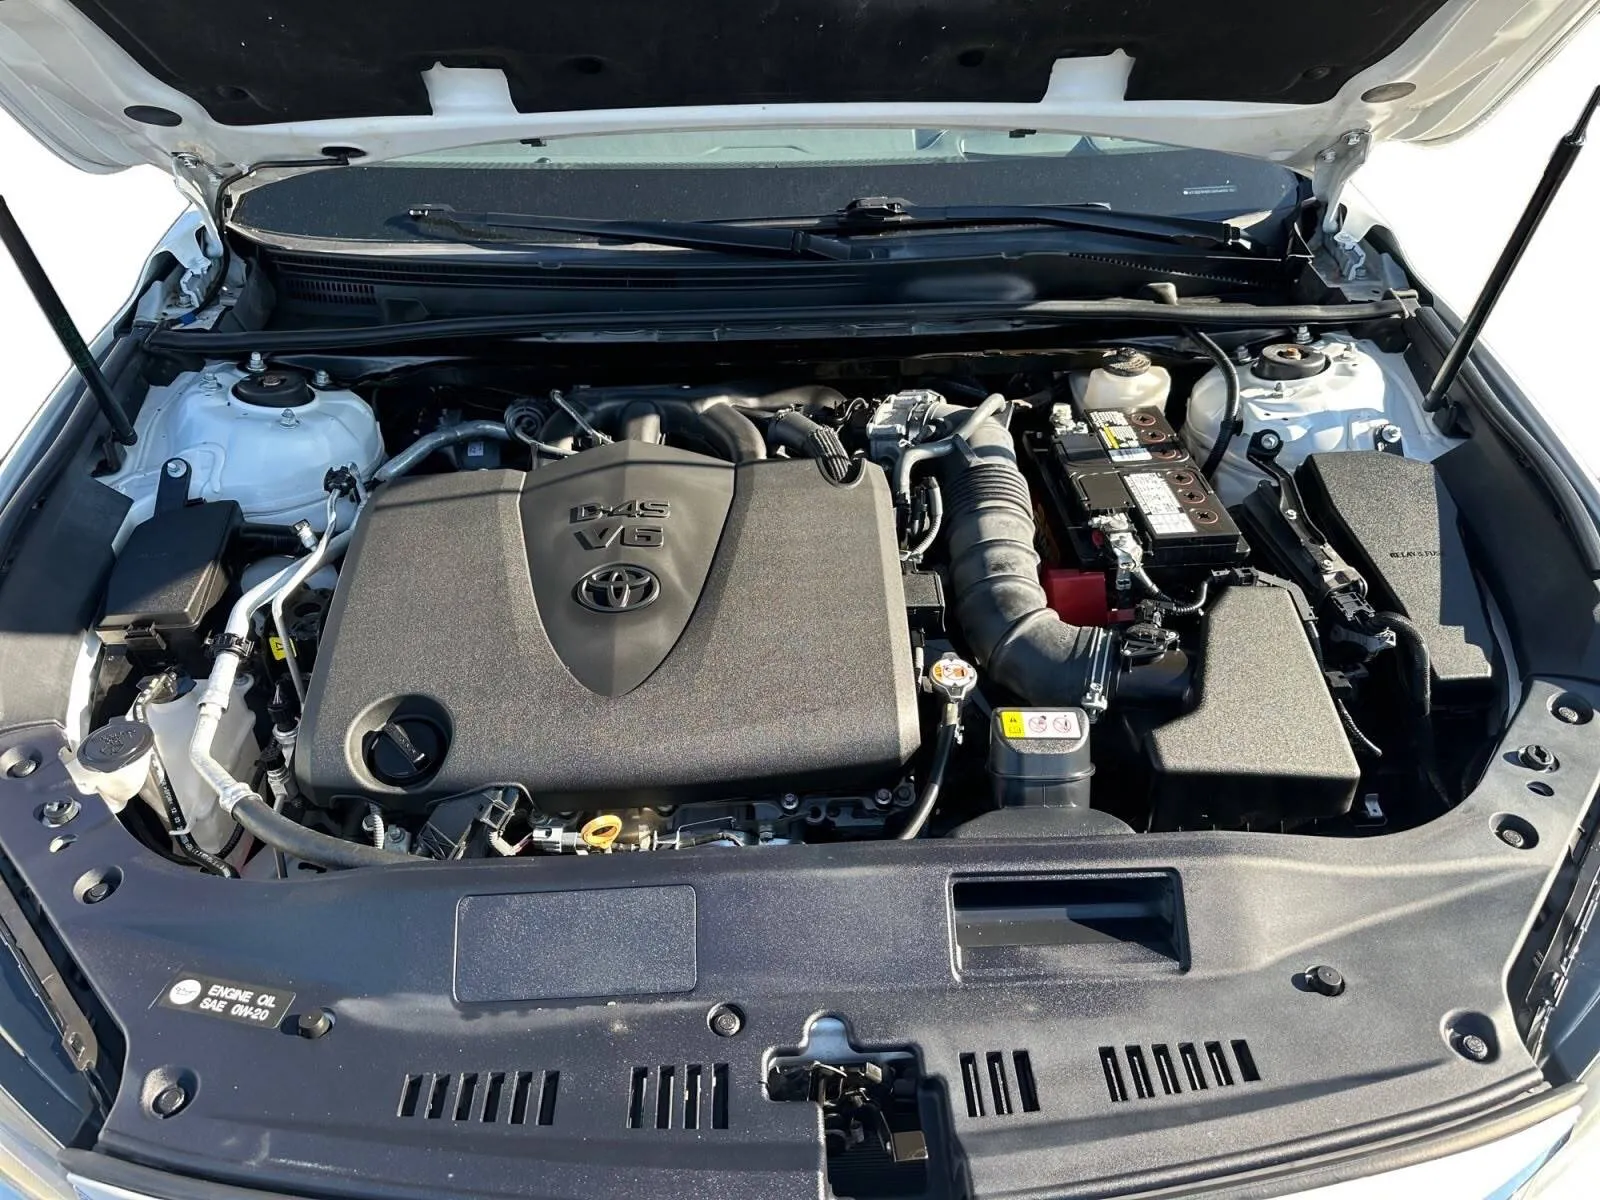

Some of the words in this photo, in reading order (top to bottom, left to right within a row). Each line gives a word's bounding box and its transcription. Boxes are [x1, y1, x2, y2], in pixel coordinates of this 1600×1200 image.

[573, 525, 664, 550] V6
[208, 984, 254, 1003] ENGINE
[257, 994, 276, 1008] OIL
[200, 997, 228, 1012] SAE
[231, 1003, 270, 1021] 0W-20
